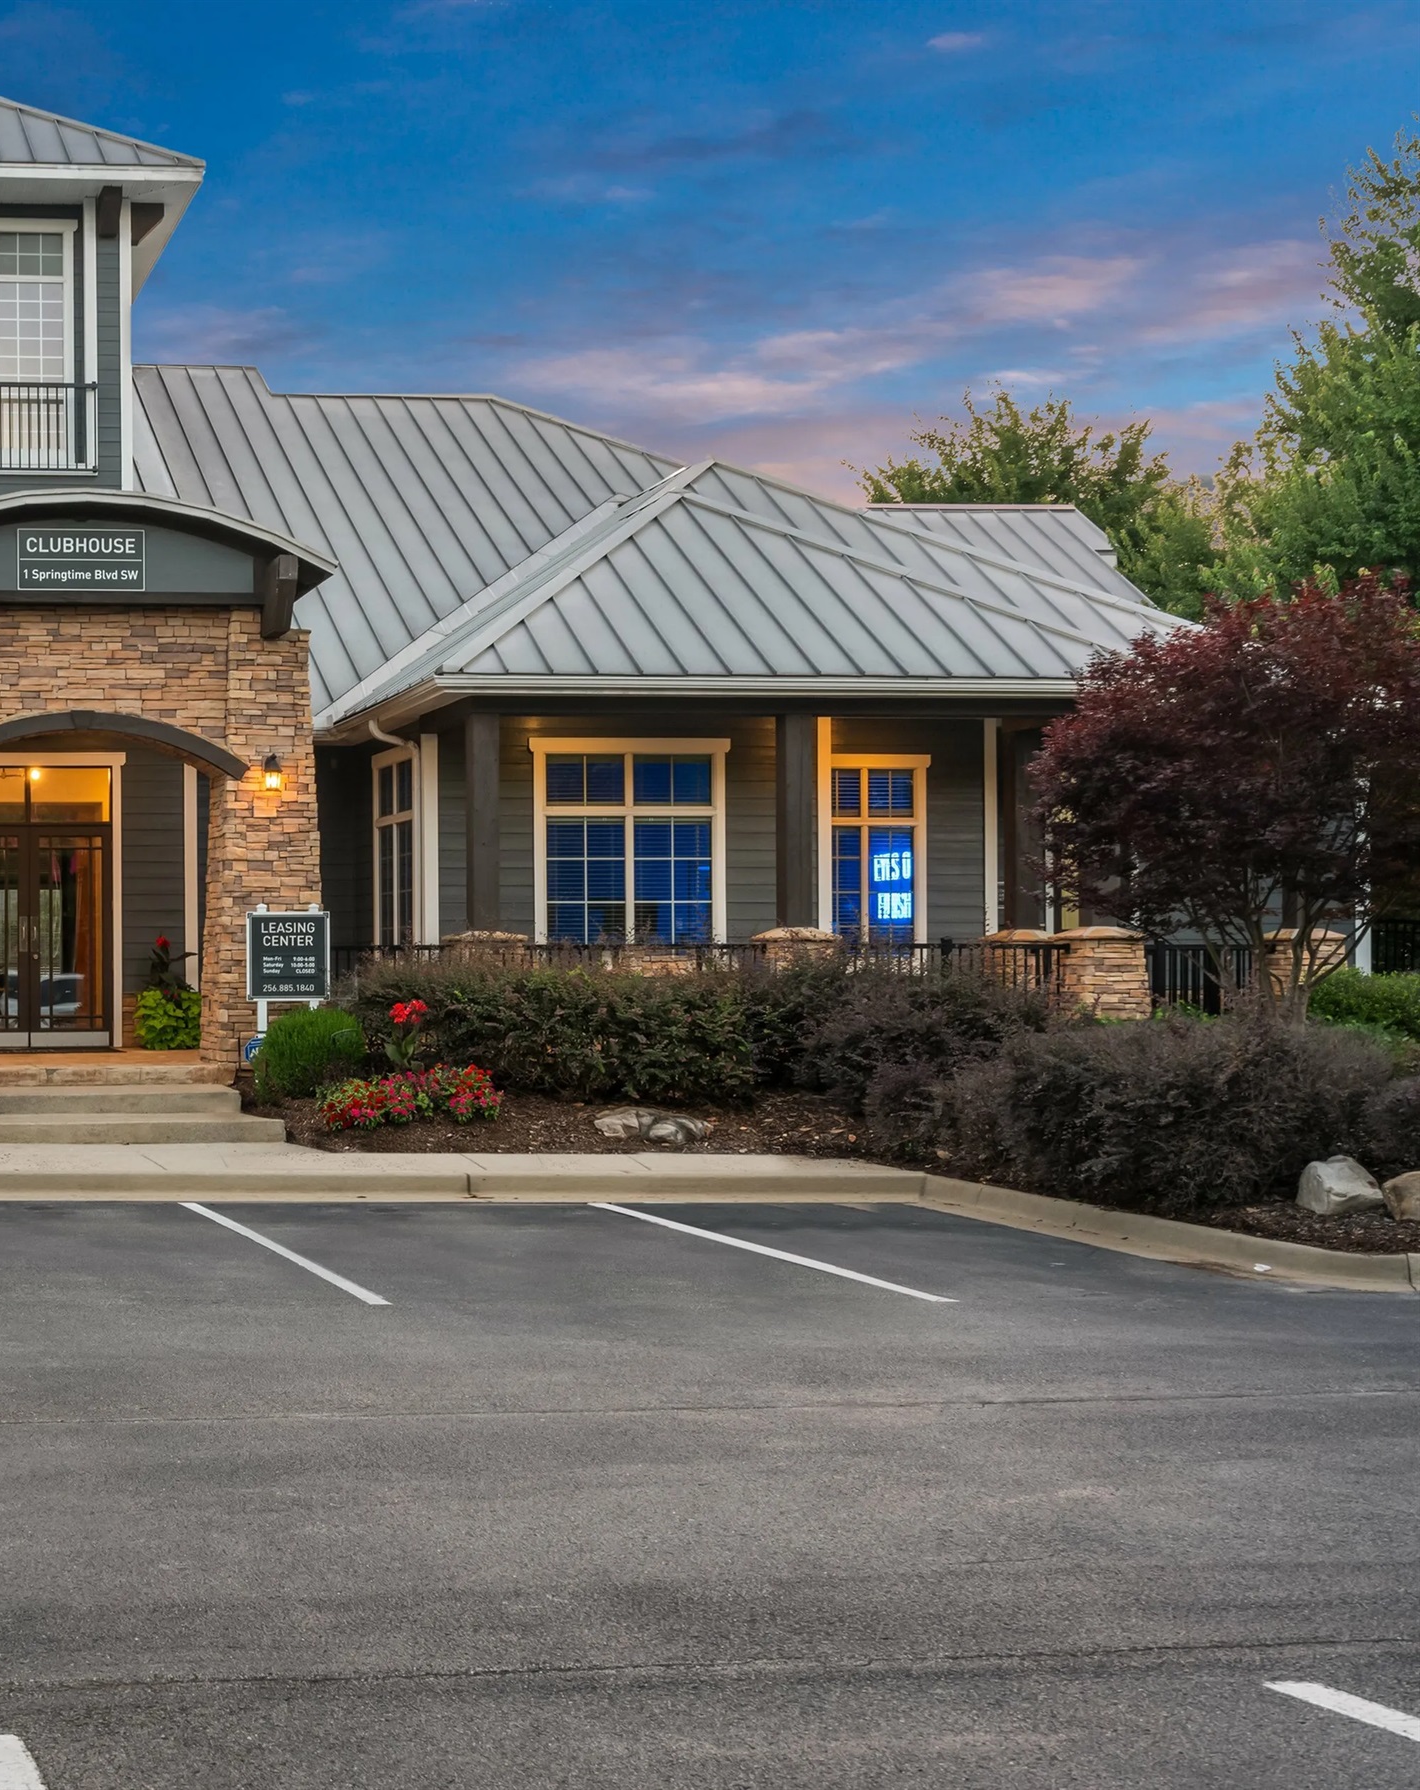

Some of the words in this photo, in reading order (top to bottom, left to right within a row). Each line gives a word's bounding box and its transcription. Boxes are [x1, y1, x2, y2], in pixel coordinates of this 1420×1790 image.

[26, 537, 136, 554] CLUBHOUSE
[23, 569, 29, 580] 1
[32, 569, 92, 582] Springtime
[95, 570, 118, 580] Blvd
[120, 570, 139, 580] SW
[261, 922, 316, 934] LEASING
[262, 935, 314, 947] CENTER
[262, 984, 315, 992] 256.885.1840
